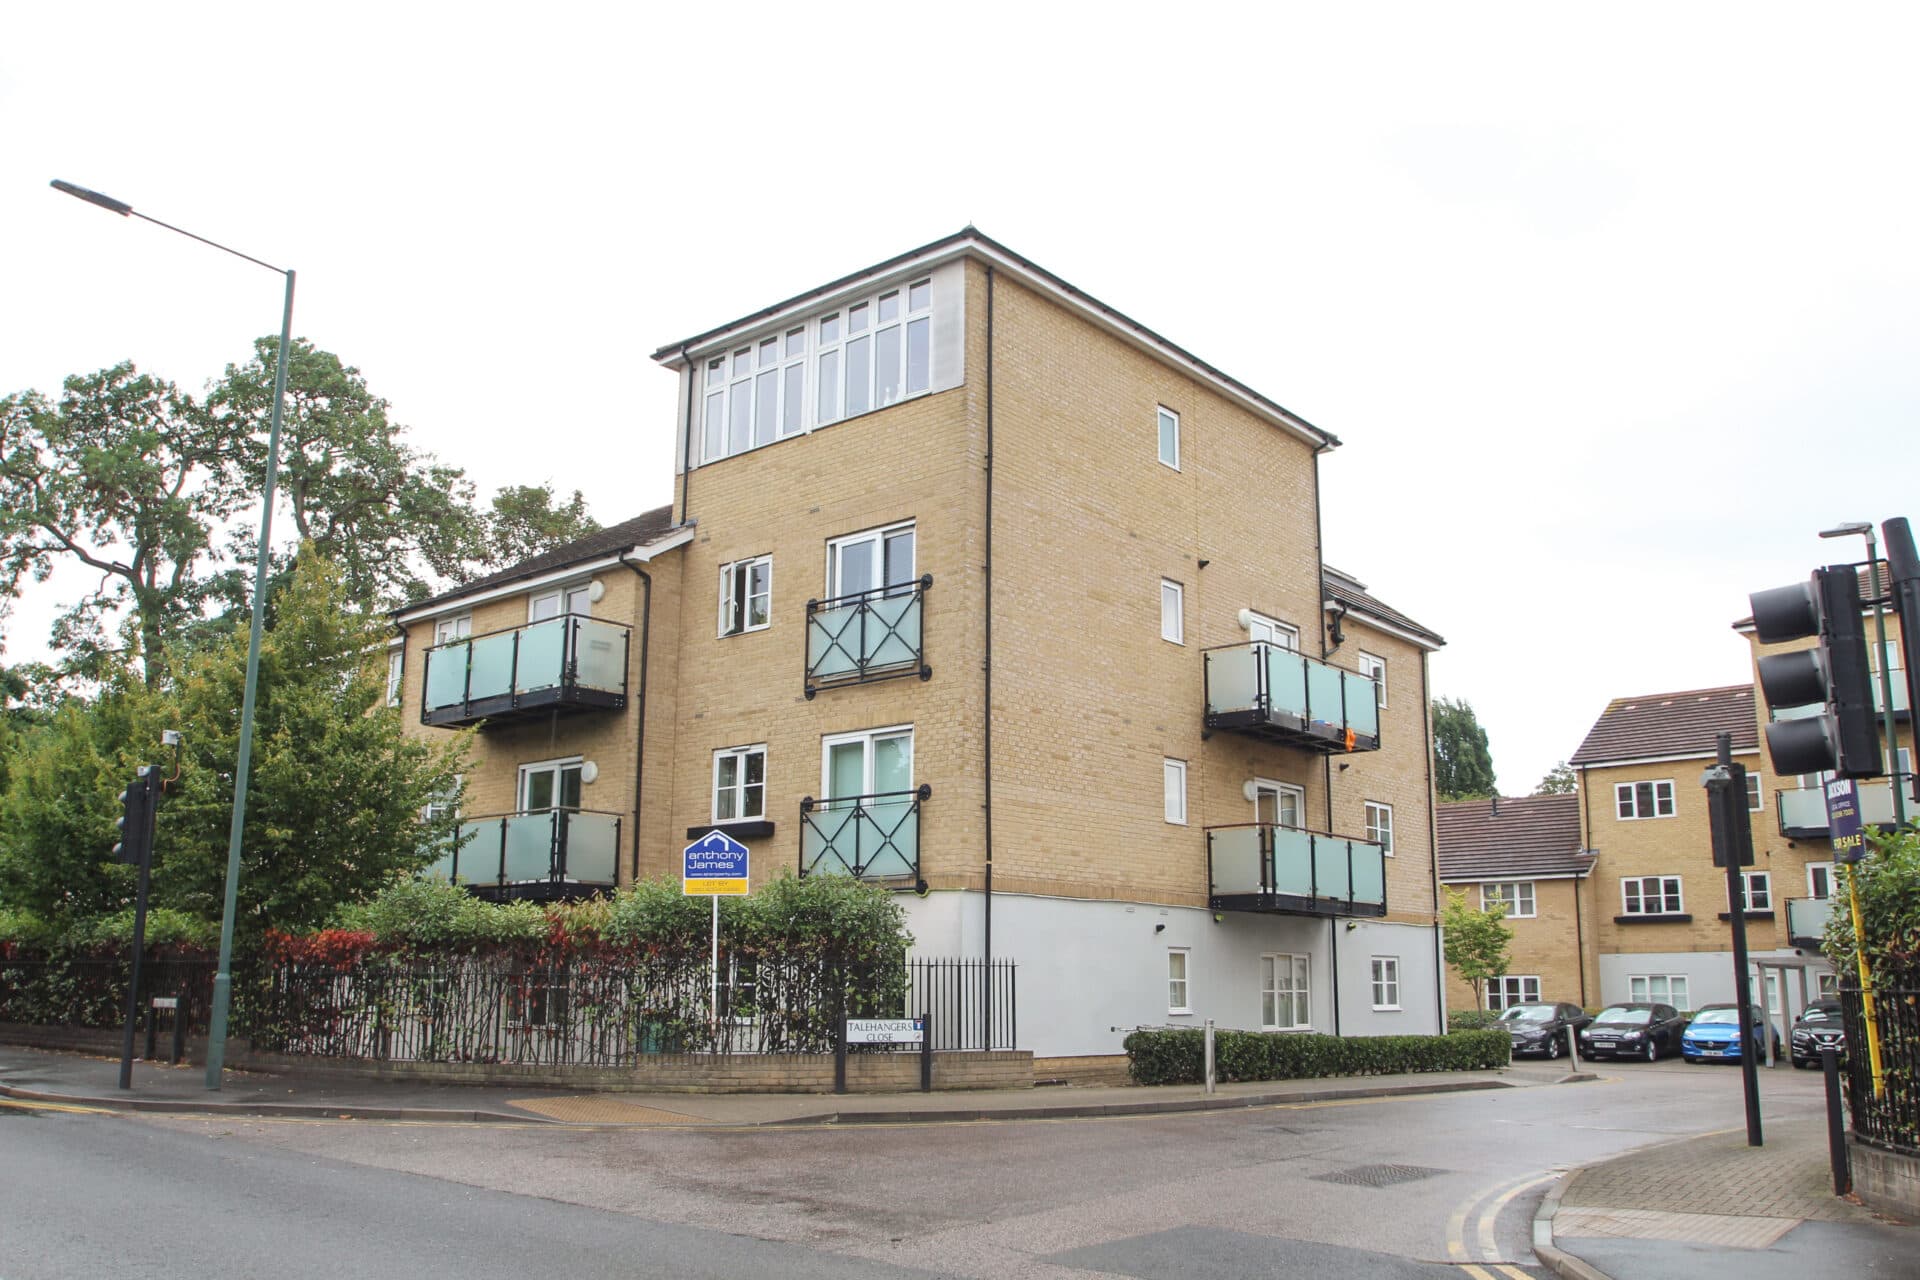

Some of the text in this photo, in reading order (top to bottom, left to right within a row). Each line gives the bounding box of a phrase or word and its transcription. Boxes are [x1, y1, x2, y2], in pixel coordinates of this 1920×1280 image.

[1842, 834, 1861, 848] SALE
[688, 851, 744, 862] anthony
[688, 860, 734, 869] James
[848, 1022, 913, 1031] TALEHANGERS
[866, 1033, 893, 1041] CLOSE
